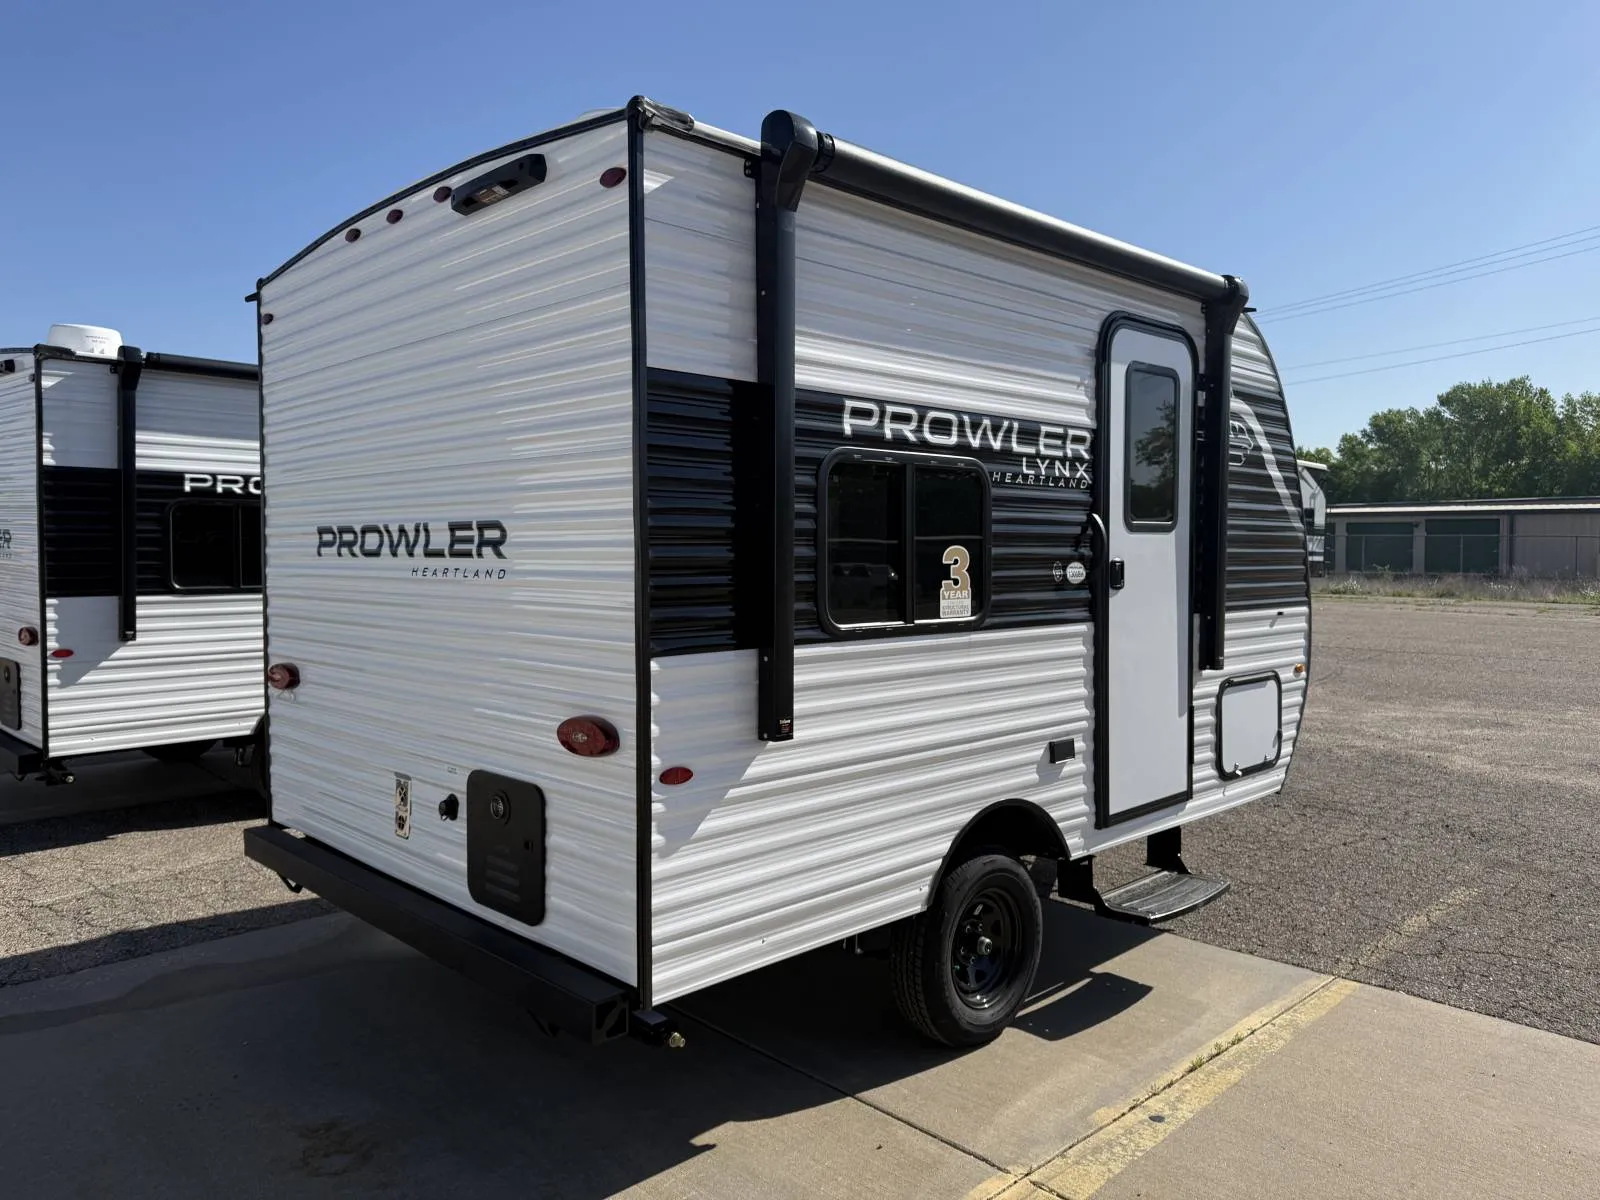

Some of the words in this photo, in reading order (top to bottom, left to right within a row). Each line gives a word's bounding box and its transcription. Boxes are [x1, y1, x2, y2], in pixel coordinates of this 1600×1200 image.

[843, 399, 1092, 459] PROWLER
[992, 471, 1088, 489] HEARTLAND
[1022, 457, 1092, 484] LYNX
[317, 520, 508, 559] PROWLER
[411, 567, 506, 580] HEARTLAND
[942, 545, 971, 590] 3
[943, 590, 969, 599] YEAR
